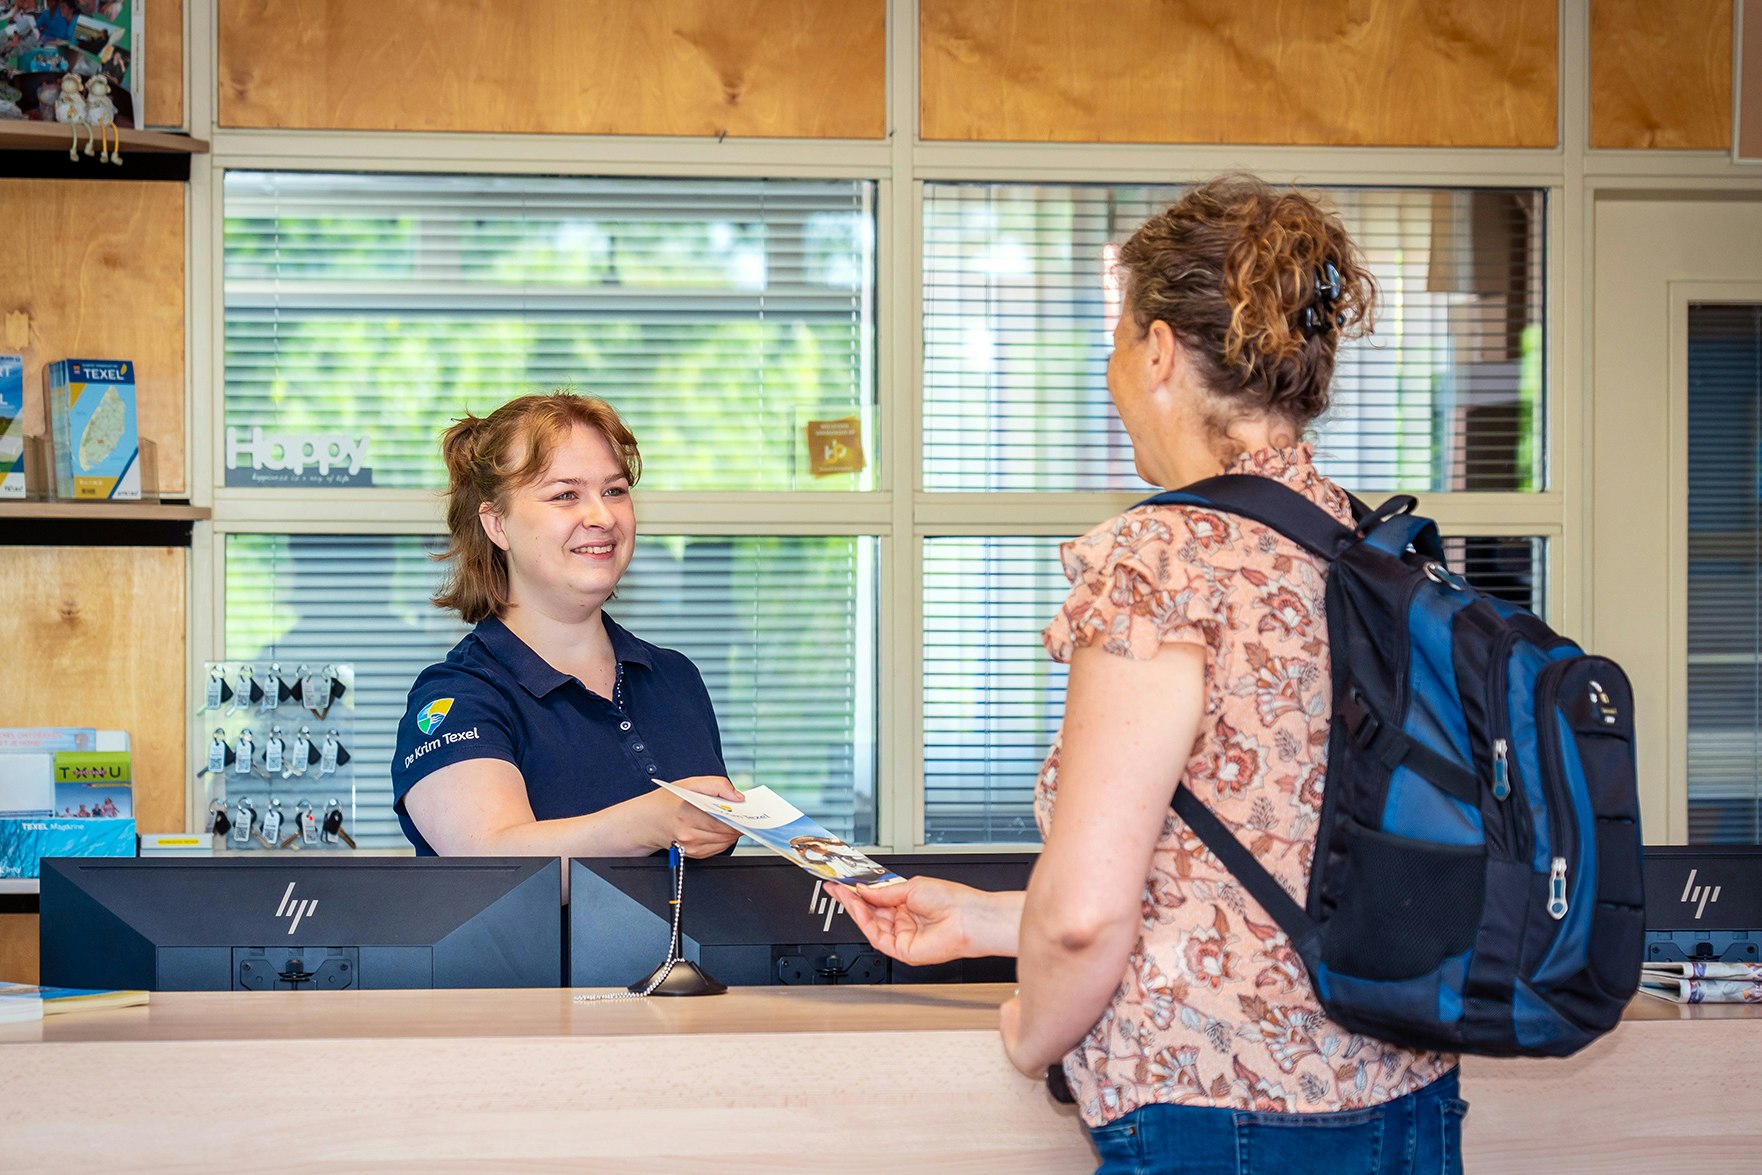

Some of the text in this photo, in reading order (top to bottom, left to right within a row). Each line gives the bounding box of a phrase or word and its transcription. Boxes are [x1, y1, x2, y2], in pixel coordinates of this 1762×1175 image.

[83, 368, 124, 380] TEXEL
[226, 426, 370, 476] Happy
[404, 727, 480, 769] De Krim Texel
[21, 822, 49, 831] TEXEL
[275, 881, 319, 935] hp
[1680, 868, 1722, 919] hp
